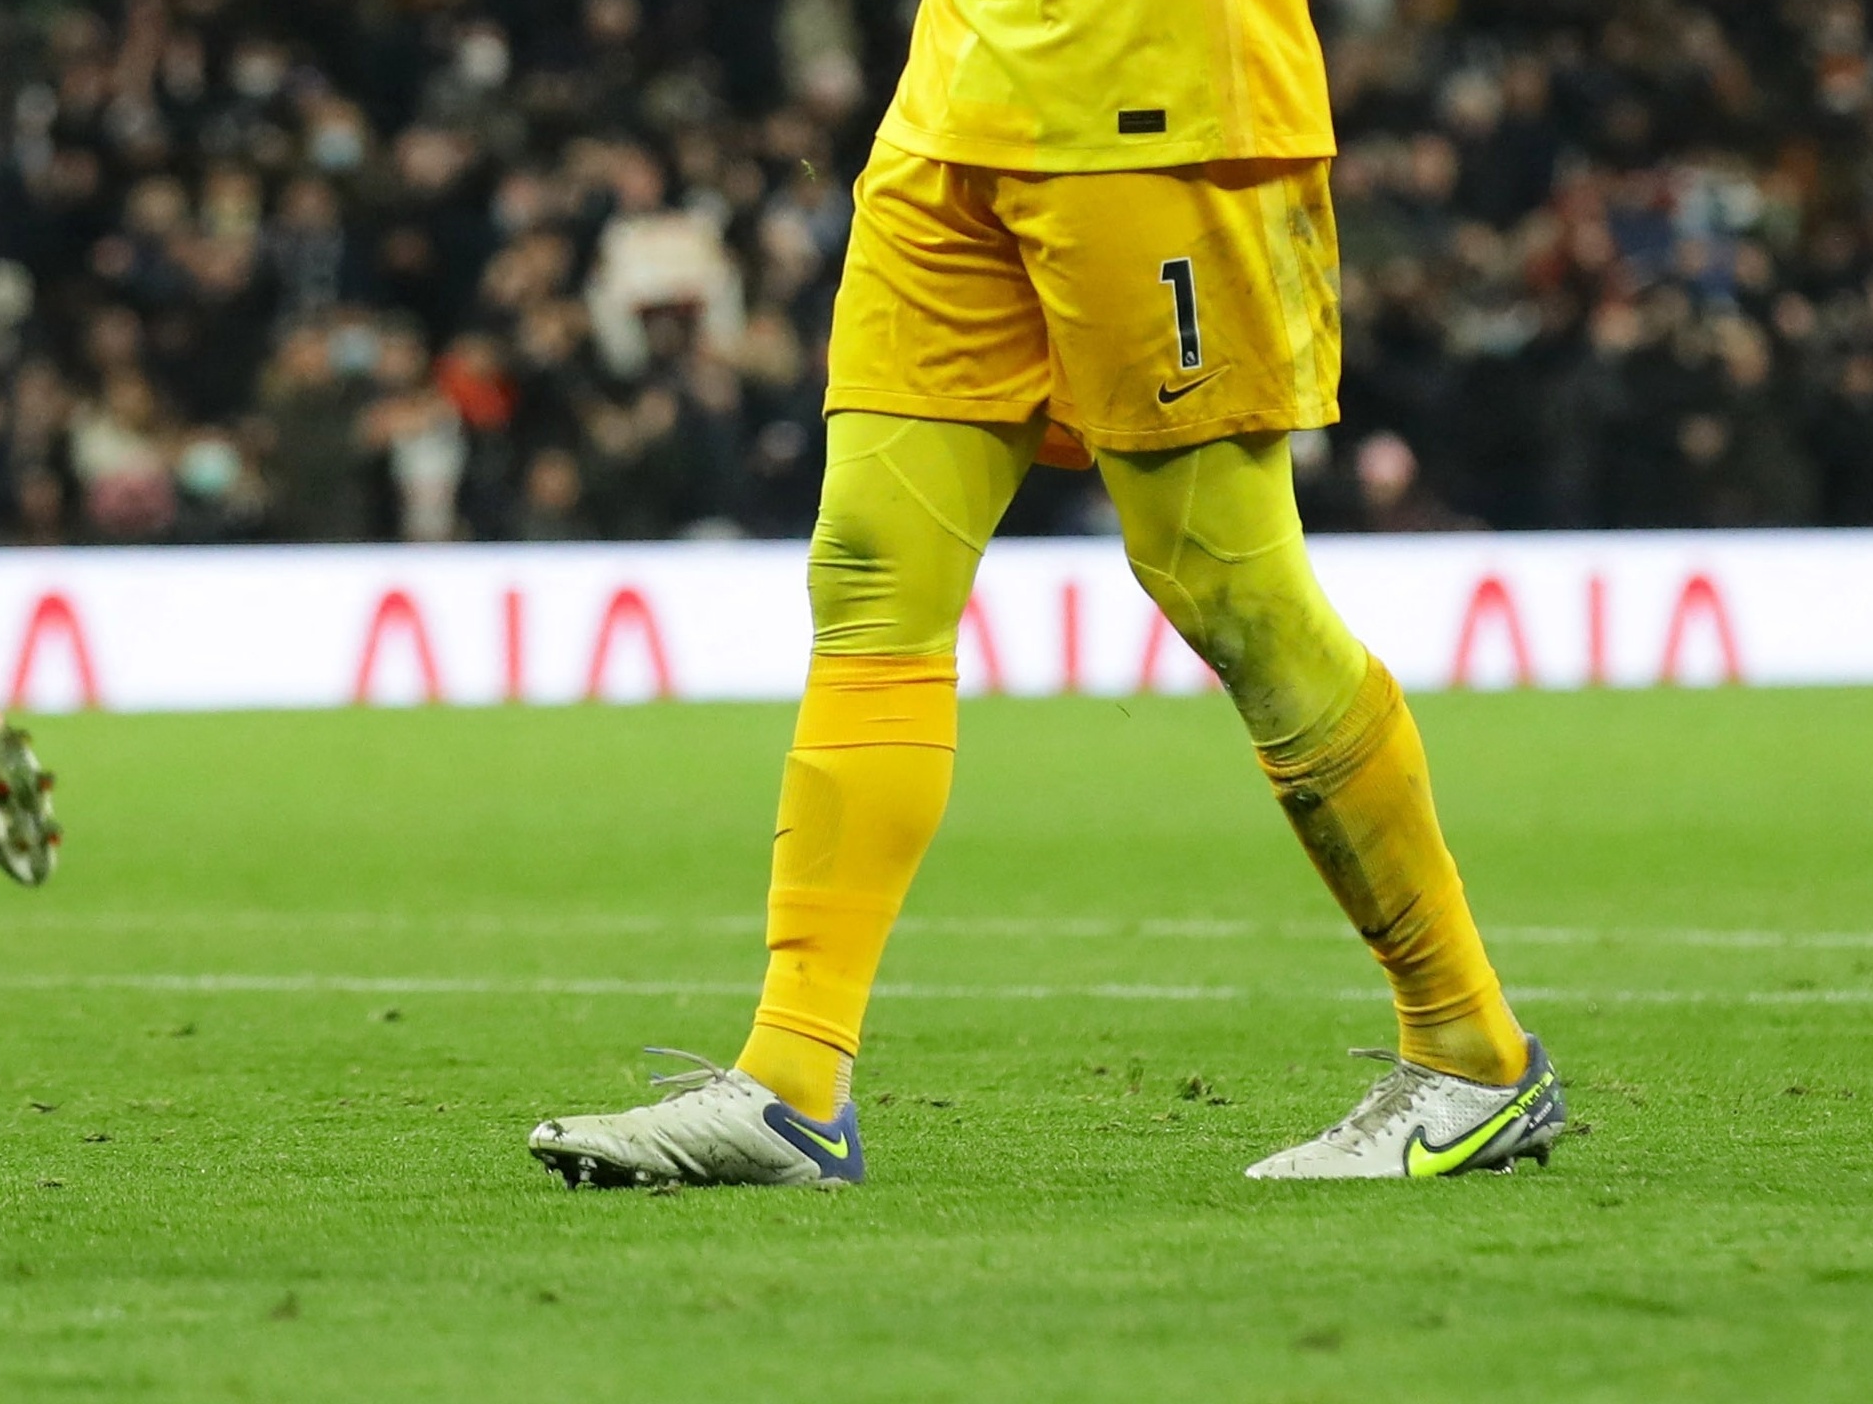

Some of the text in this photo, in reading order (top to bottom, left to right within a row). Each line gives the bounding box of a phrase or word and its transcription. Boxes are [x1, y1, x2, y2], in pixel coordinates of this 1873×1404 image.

[1159, 256, 1202, 369] 1
[355, 586, 674, 699] AIA
[1453, 572, 1740, 680] AIA
